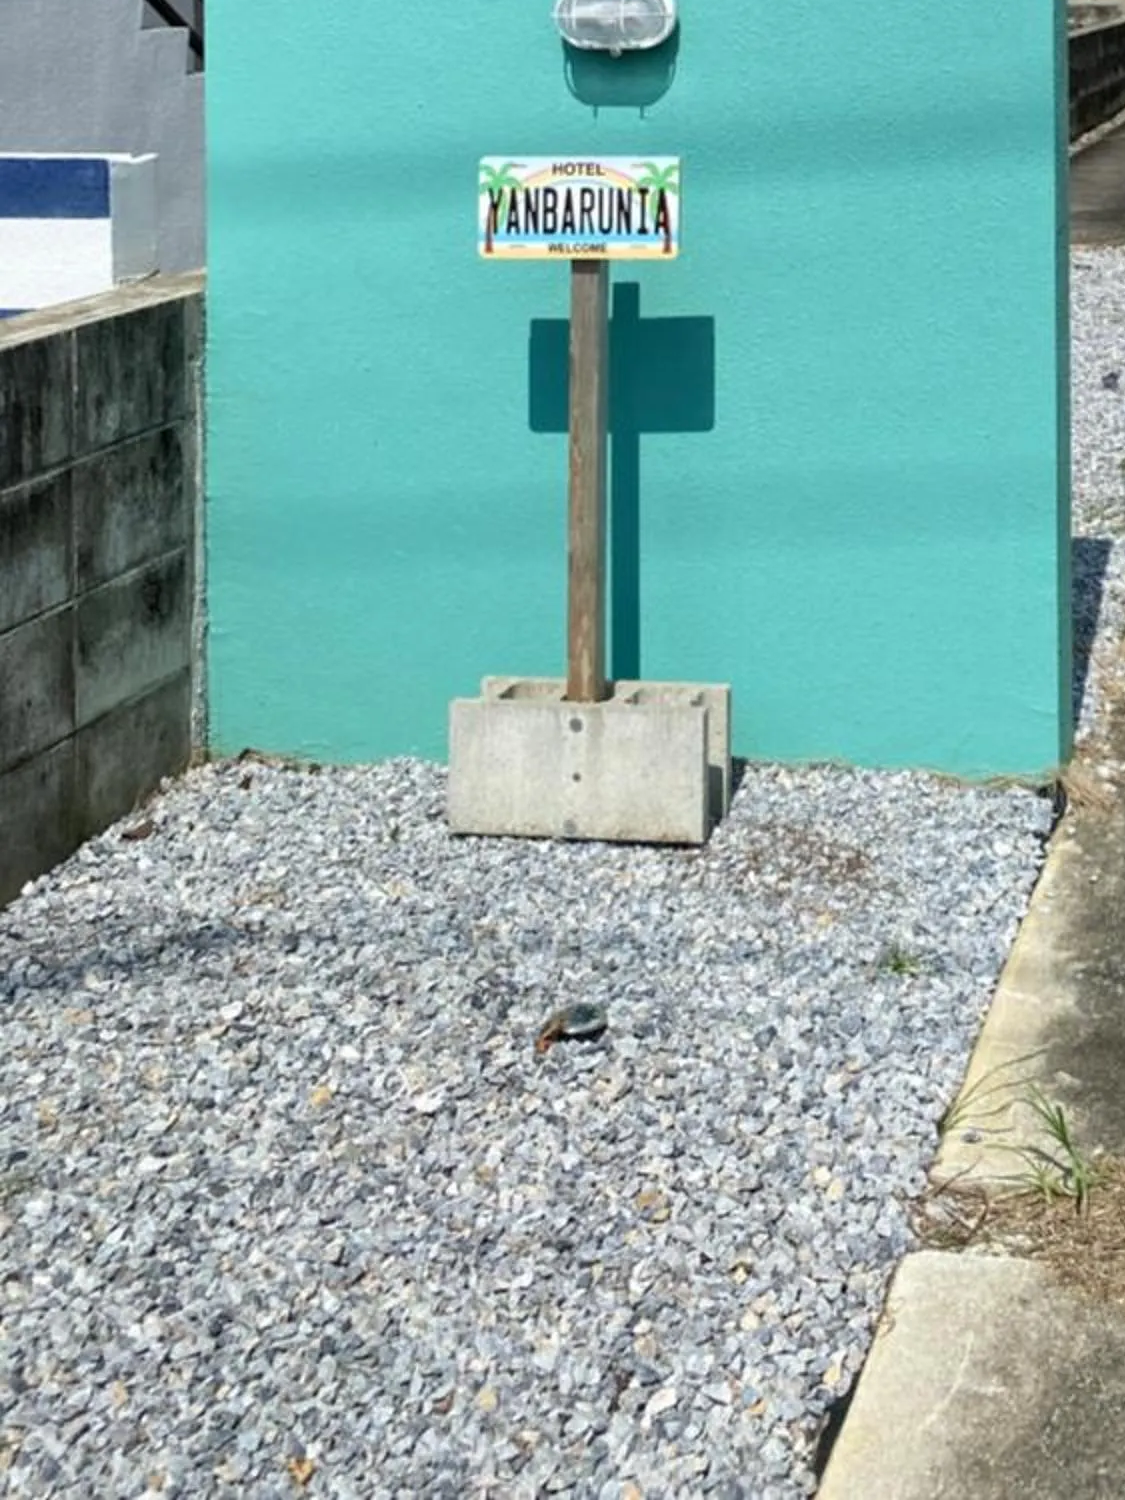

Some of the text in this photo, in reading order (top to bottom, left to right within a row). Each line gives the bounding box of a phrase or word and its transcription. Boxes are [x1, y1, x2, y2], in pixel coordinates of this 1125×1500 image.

[551, 162, 606, 177] HOTEL
[487, 187, 671, 236] YANBARUNIA
[548, 242, 608, 254] WELCOME
